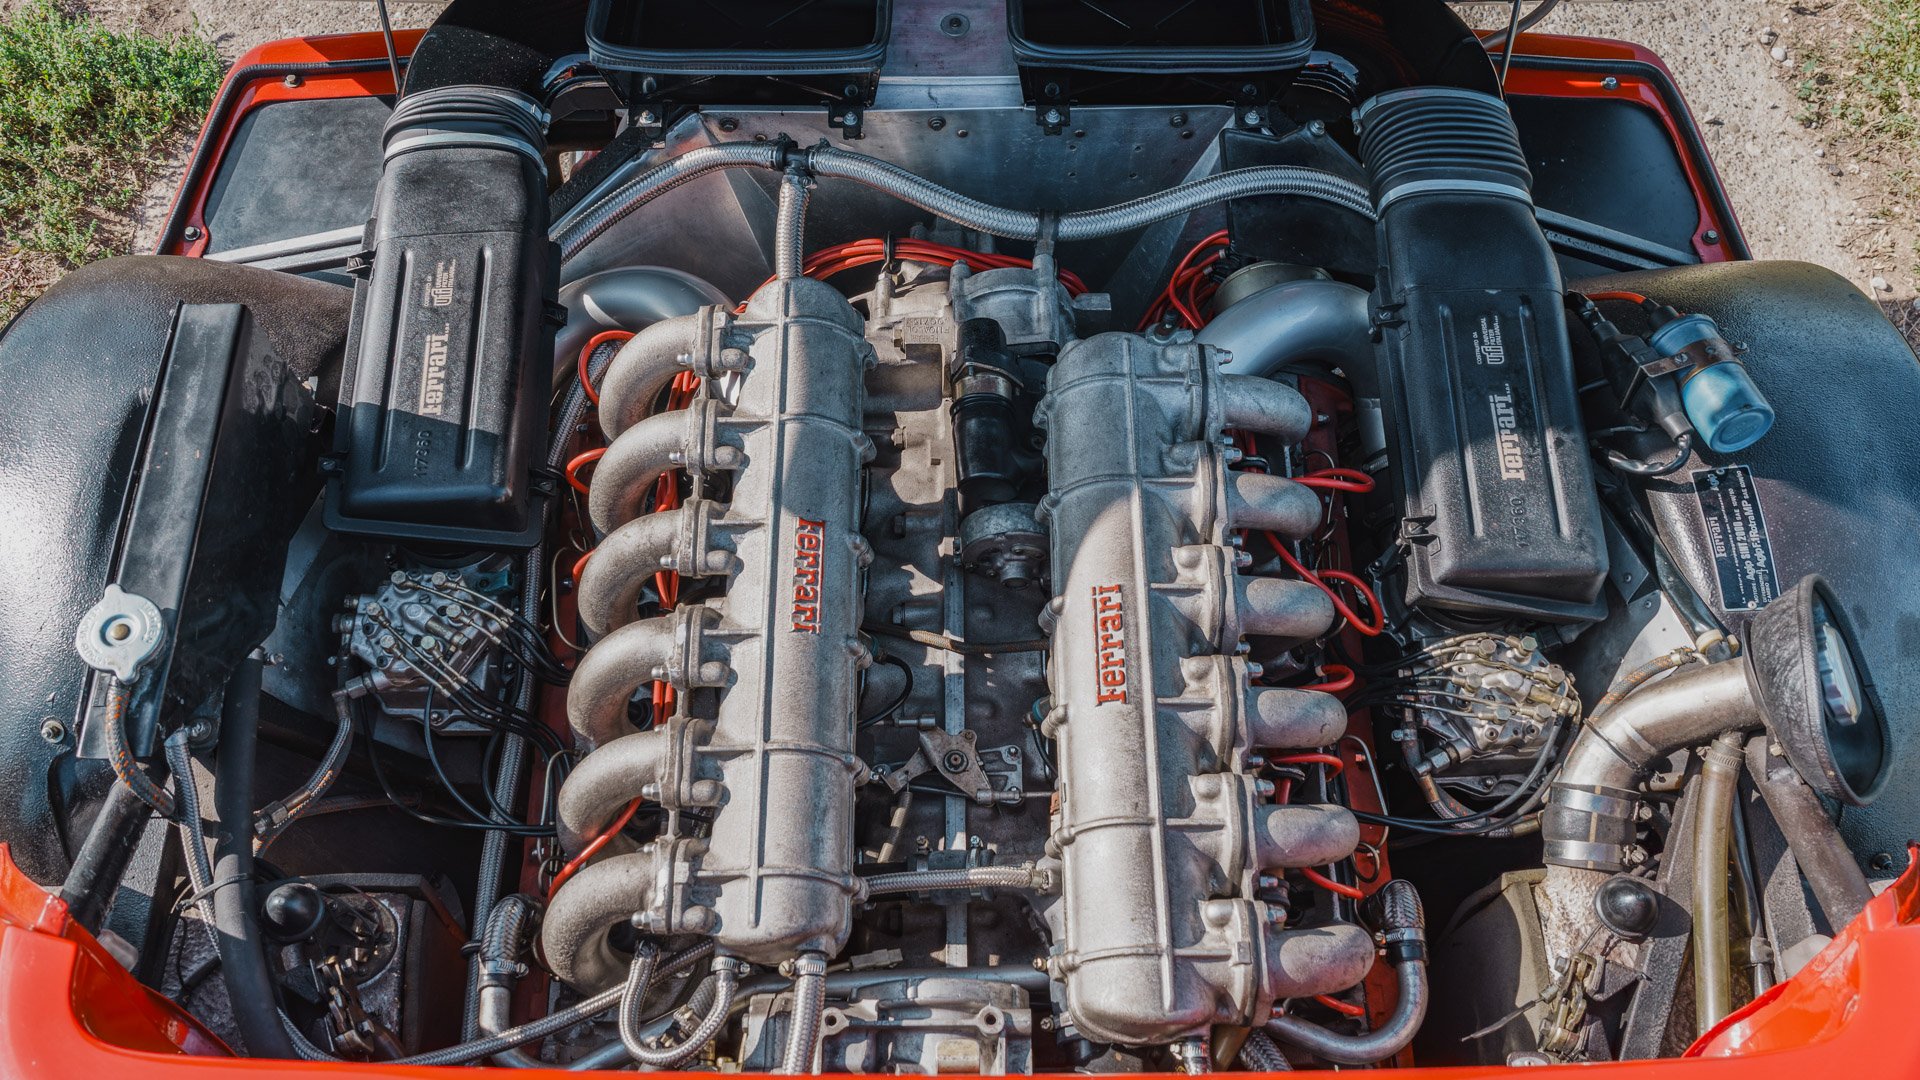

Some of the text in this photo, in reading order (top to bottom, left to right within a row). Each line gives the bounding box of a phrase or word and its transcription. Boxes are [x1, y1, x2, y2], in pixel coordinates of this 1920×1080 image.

[1480, 317, 1490, 346] UNIVERSAL
[1488, 329, 1496, 345] FILTER
[1472, 331, 1482, 365] COSTRUITO DA
[418, 333, 449, 416] Ferrari
[1489, 394, 1526, 481] Ferrari
[1707, 474, 1719, 491] Agip
[1734, 509, 1742, 521] SAE
[1706, 516, 1727, 558] Ferrari
[1733, 521, 1746, 541] 2000
[1744, 560, 1756, 580] Agip
[1754, 548, 1767, 568] Agip
[793, 516, 825, 635] Ferrari
[1091, 584, 1127, 706] Ferrari
